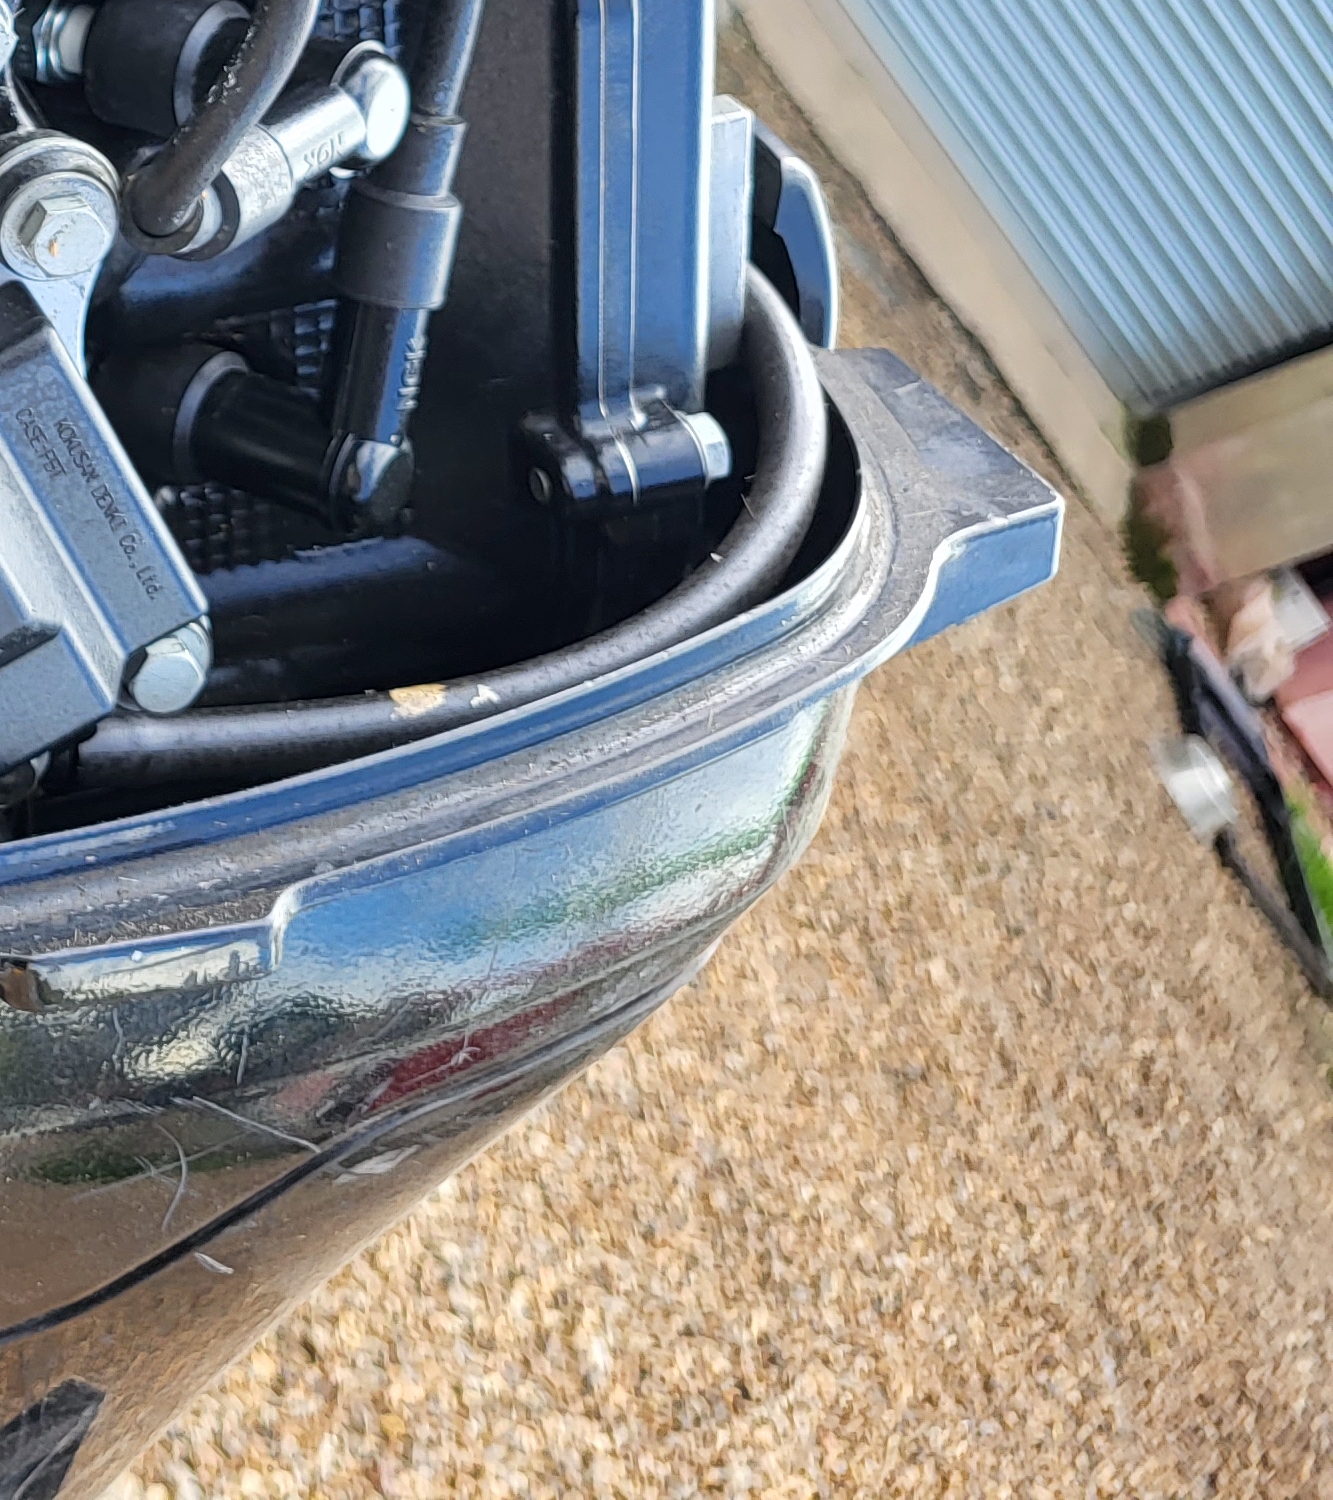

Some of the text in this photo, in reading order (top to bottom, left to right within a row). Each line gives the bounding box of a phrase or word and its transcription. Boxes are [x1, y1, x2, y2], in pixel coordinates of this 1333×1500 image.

[397, 336, 426, 411] NGK
[54, 417, 100, 485] KOKUSAN
[90, 482, 128, 533] DENKI
